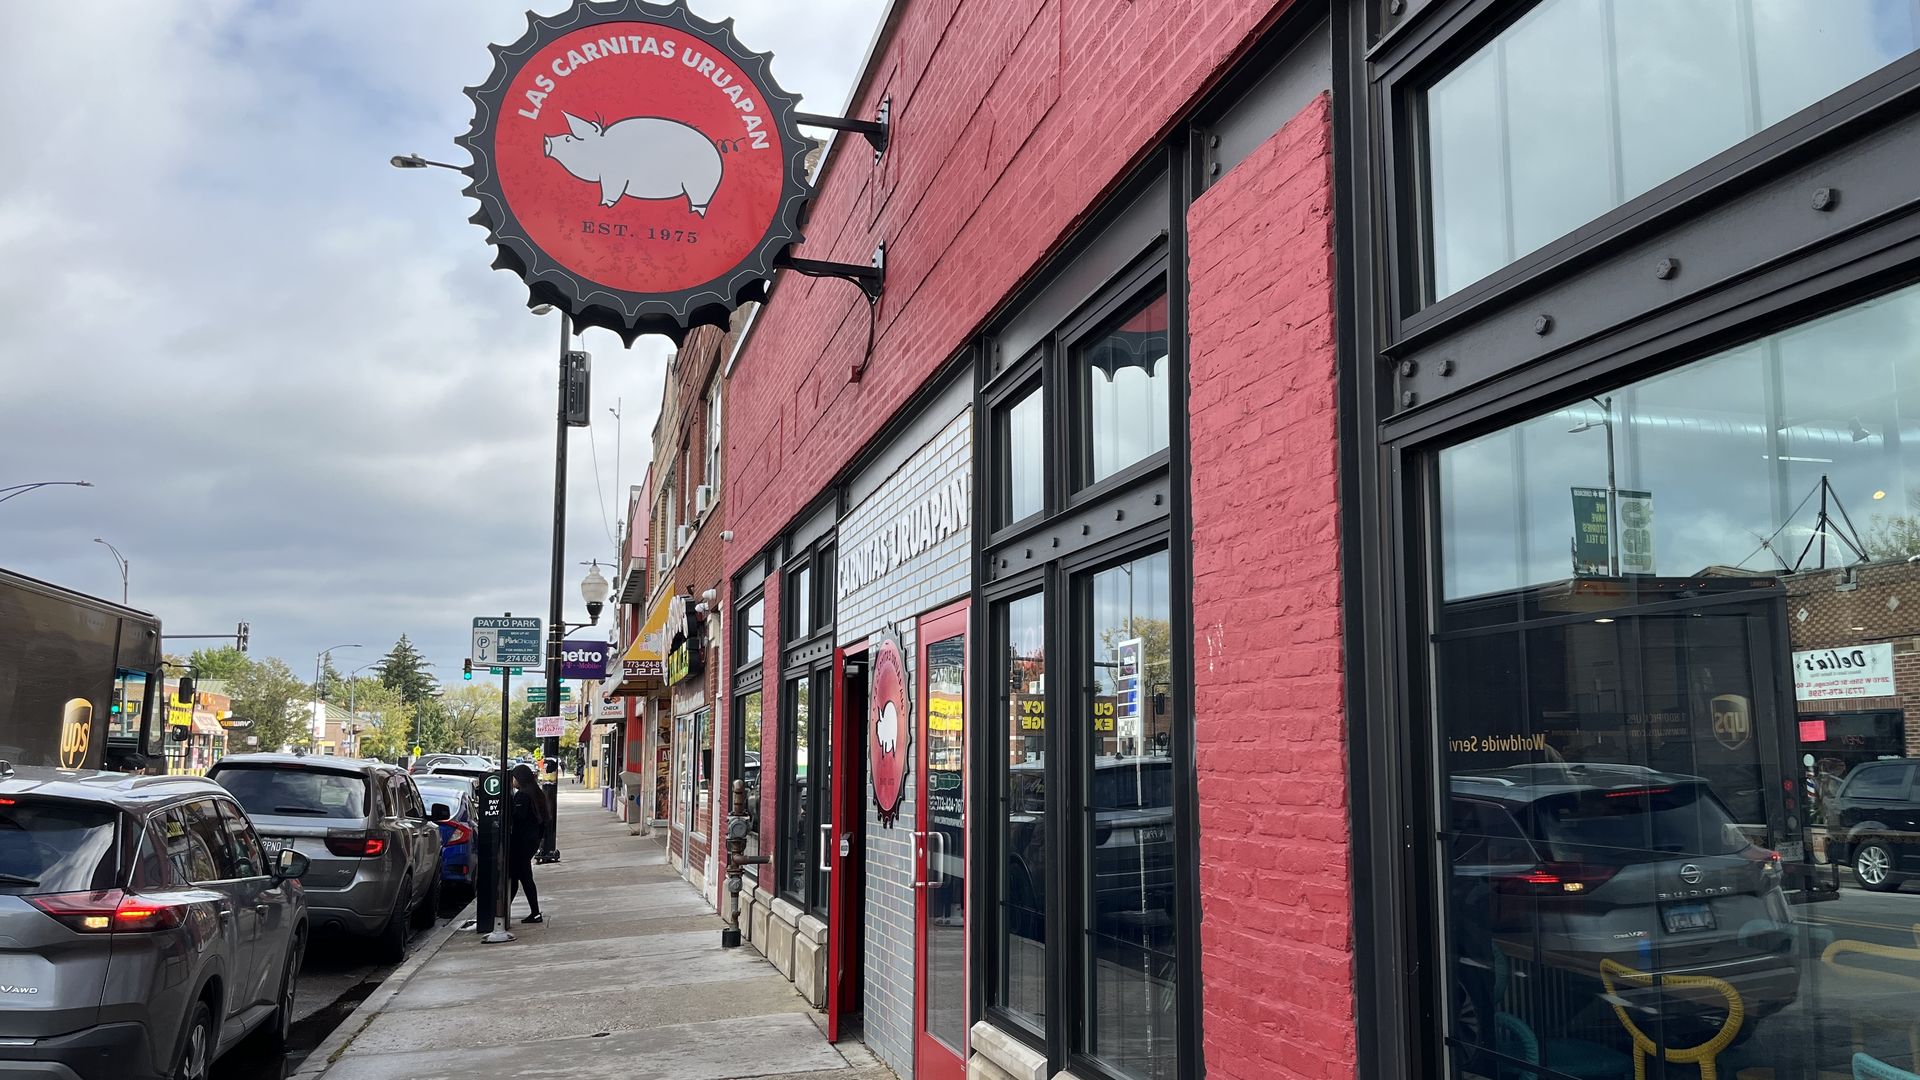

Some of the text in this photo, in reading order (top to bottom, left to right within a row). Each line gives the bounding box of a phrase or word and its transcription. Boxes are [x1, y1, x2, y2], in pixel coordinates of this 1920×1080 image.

[517, 35, 770, 151] LAS CARNITAS URUAPAN
[581, 220, 699, 244] EST. 1975
[838, 472, 968, 601] CARNITAS URUAPAN
[478, 619, 536, 628] PAY TO PARK
[221, 719, 251, 728] SUBWAY
[62, 721, 90, 765] ups
